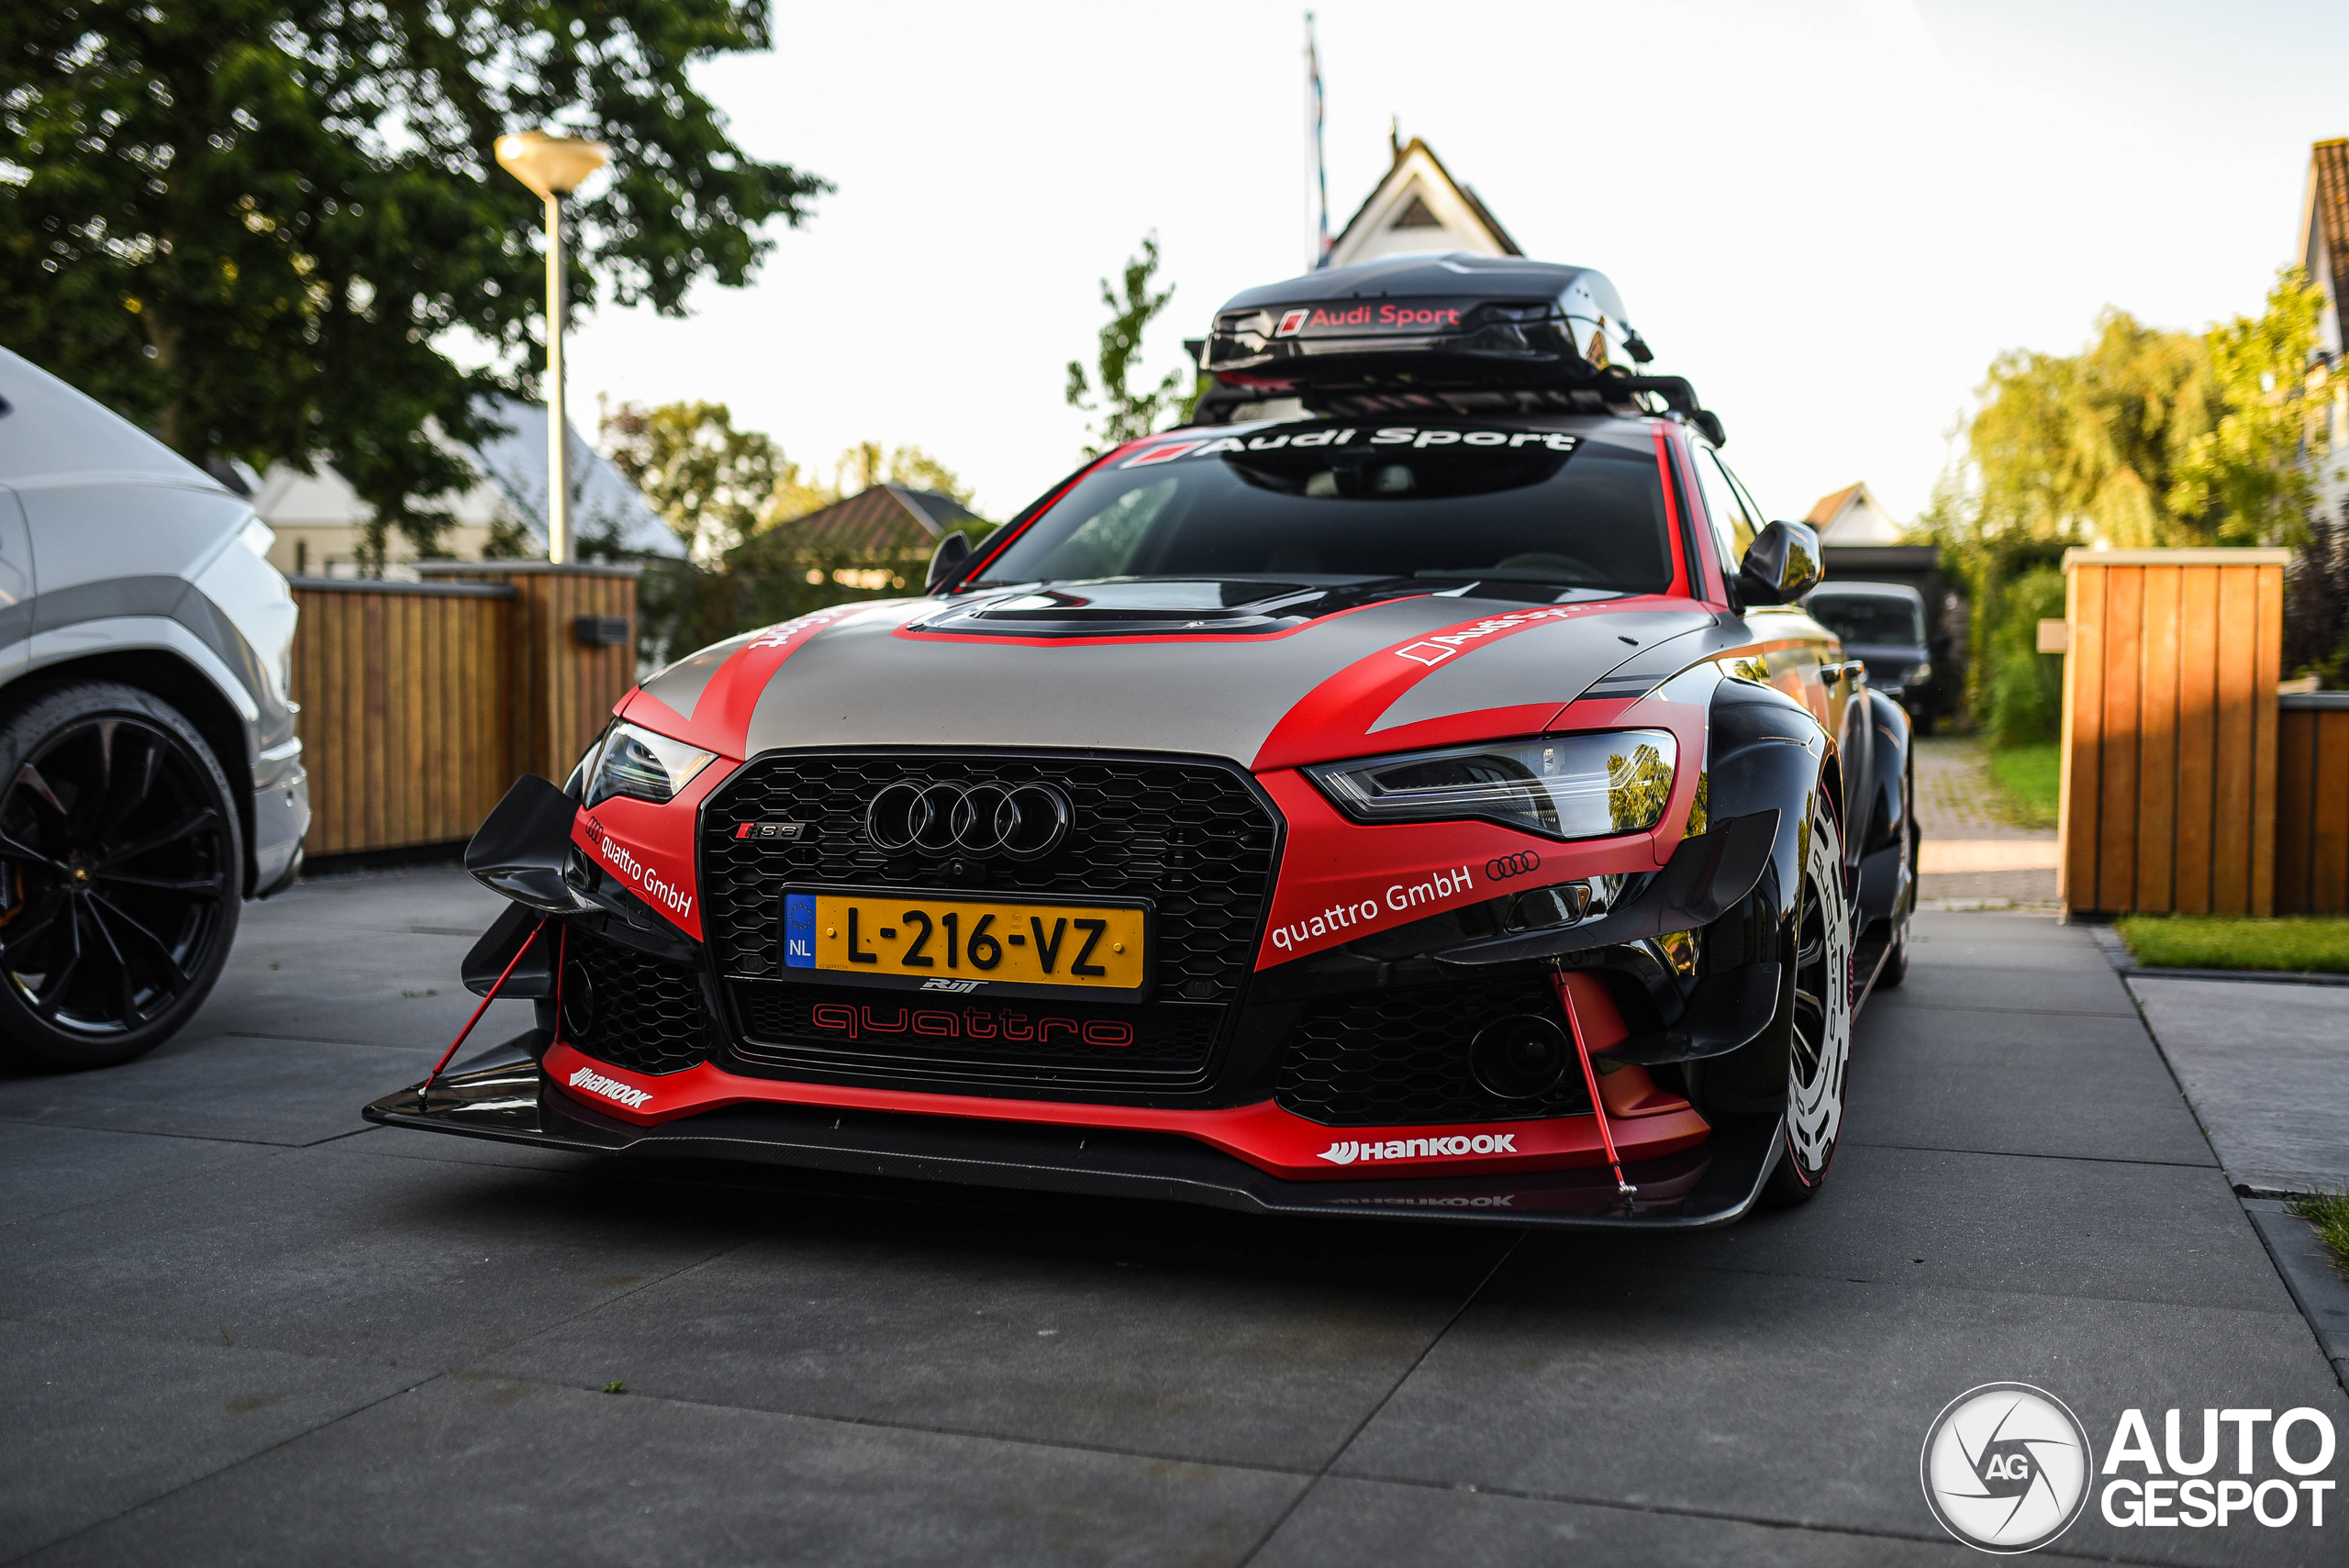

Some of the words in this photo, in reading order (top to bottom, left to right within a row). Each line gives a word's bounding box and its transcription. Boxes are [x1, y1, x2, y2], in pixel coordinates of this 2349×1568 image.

[1308, 306, 1371, 328] Audi
[1378, 305, 1460, 328] Sport
[1193, 428, 1356, 457] Audi
[1370, 428, 1575, 450] Sport
[1430, 619, 1526, 646] Audi
[601, 836, 641, 881] quattro
[644, 868, 692, 917] GmbH
[1272, 900, 1377, 951] quattro
[1386, 865, 1474, 911] GmbH
[789, 939, 811, 957] NL
[848, 906, 1106, 976] L-216-VZ
[812, 1002, 1134, 1047] quattro
